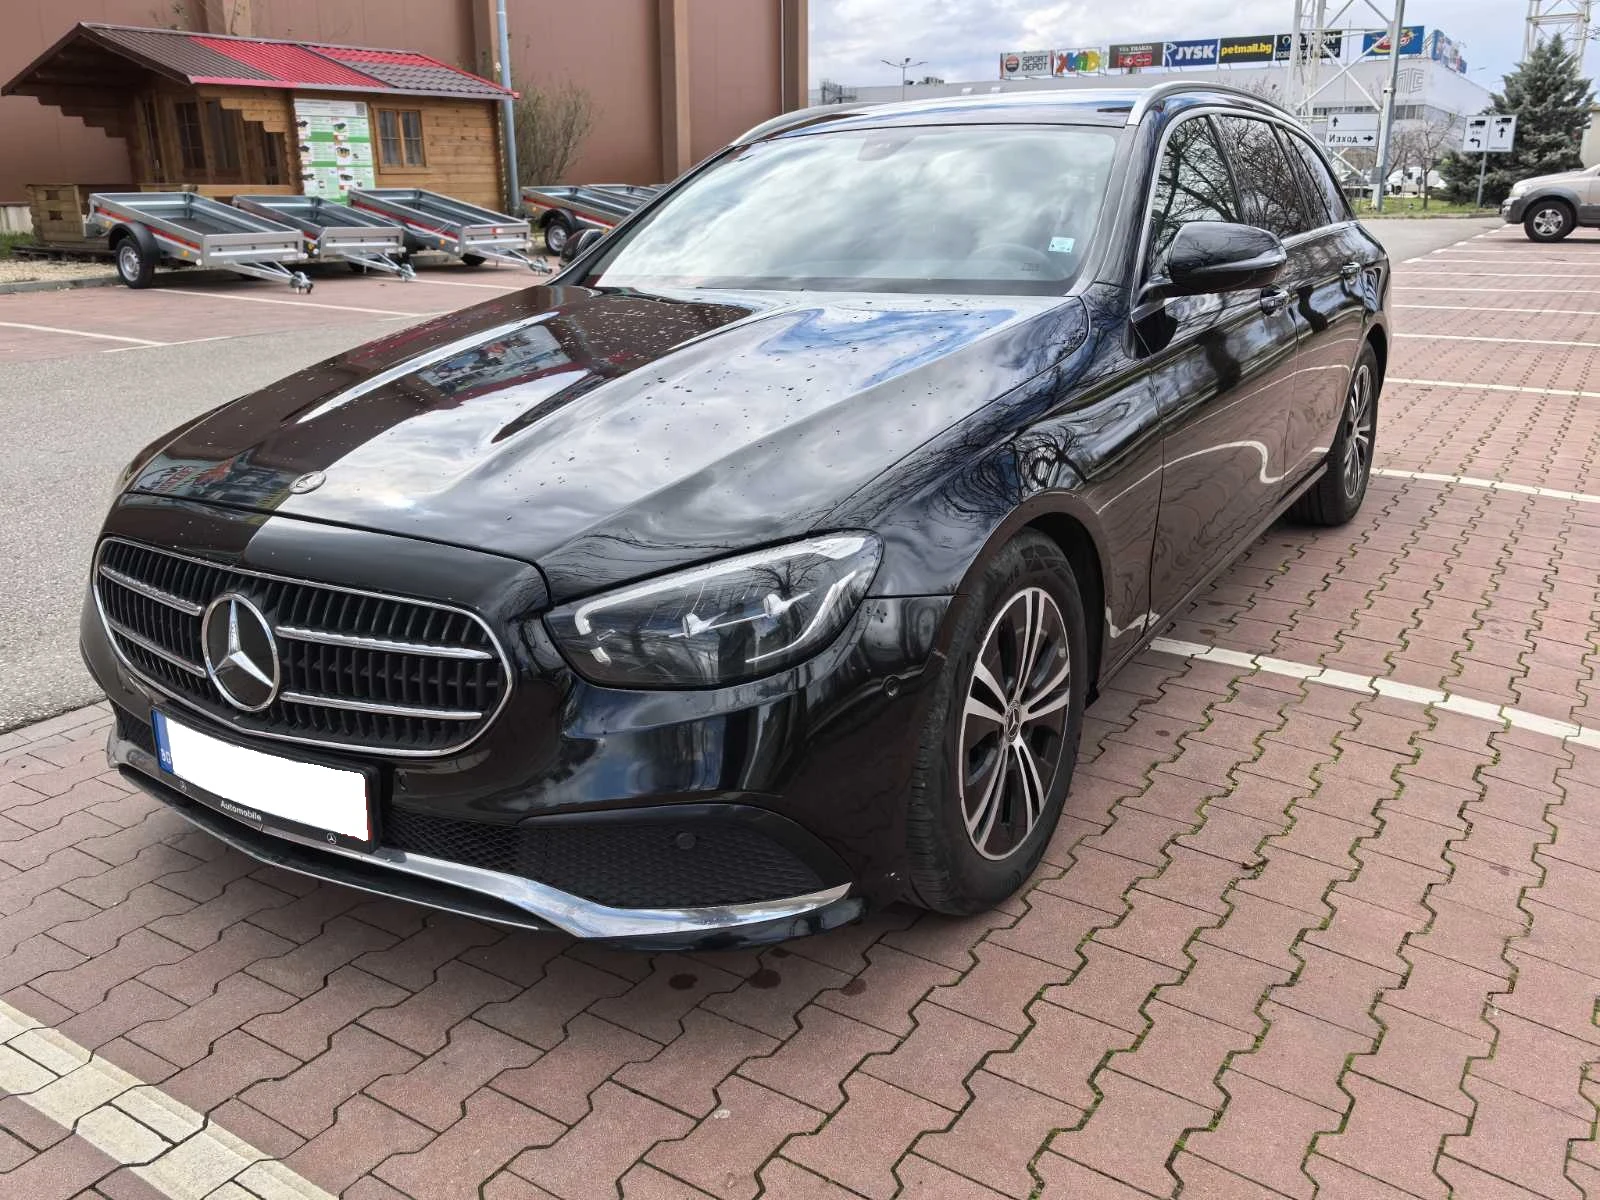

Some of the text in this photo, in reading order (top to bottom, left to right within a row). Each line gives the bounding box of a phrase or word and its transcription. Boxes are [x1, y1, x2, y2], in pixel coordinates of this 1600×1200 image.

[1175, 45, 1215, 60] JYSK
[1022, 55, 1048, 64] SPORT
[1021, 62, 1048, 72] DEPOT
[1329, 134, 1358, 143] Изход
[220, 800, 262, 821] Automobile
